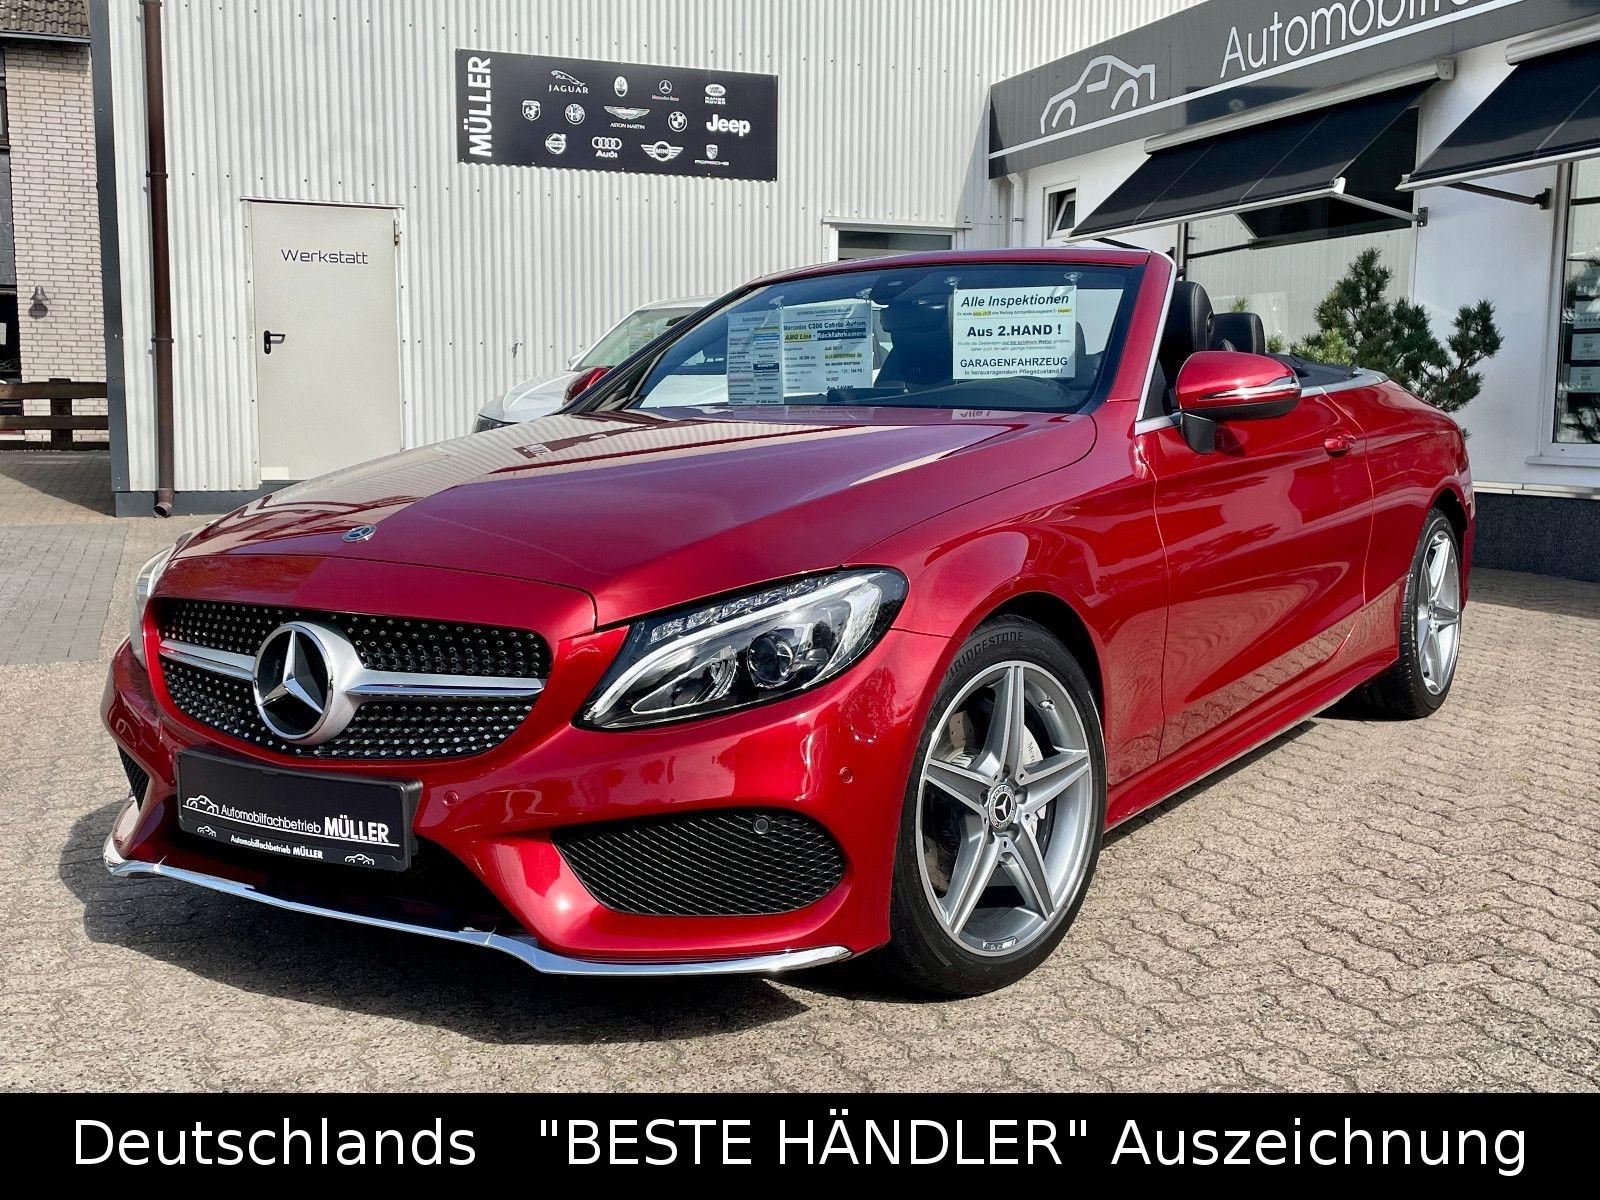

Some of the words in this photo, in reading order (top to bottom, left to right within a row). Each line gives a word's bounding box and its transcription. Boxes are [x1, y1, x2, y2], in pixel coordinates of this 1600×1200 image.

[1220, 0, 1469, 78] Automob
[548, 84, 589, 94] JAGUAR
[463, 56, 493, 158] MÜLLER
[705, 113, 751, 137] Jeep
[595, 149, 618, 158] Audi
[281, 249, 369, 265] Werkstatt
[961, 296, 985, 308] Alle
[988, 294, 1069, 308] Inspektionen
[967, 326, 993, 337] Aus
[998, 324, 1053, 337] 2.HAND
[1057, 324, 1062, 335] !
[960, 357, 1068, 368] GARAGENFAHRZEUG
[221, 804, 322, 834] Automobilfachbetrieb
[324, 815, 389, 843] MÜLLER
[230, 835, 291, 855] Automobilfachbetrieb
[293, 845, 323, 859] MÜLLER
